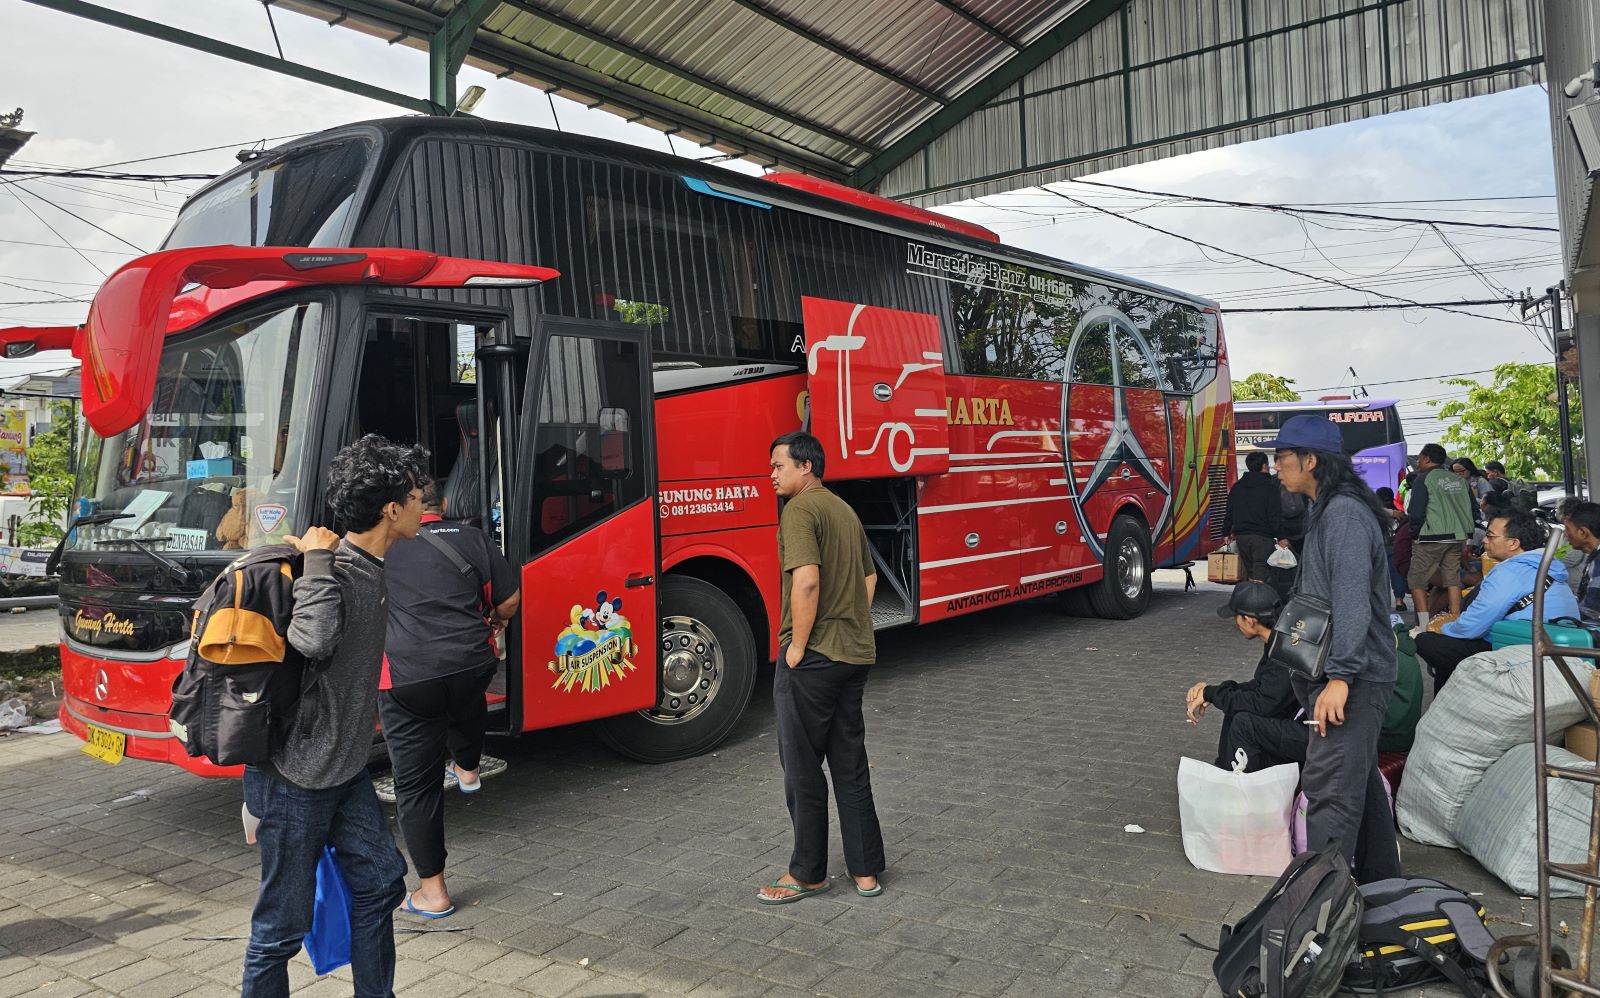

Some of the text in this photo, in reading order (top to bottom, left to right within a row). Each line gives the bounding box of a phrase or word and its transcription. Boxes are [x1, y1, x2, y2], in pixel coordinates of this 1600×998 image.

[907, 242, 1026, 287] Mercedes-Benz
[732, 366, 766, 377] JETBUS
[147, 412, 178, 422] BIL
[715, 485, 759, 500] HARTA
[671, 501, 735, 516] 08123863434
[166, 532, 205, 551] DENPASAR
[946, 573, 1082, 612] ANTAR KOTA ANTAR PROPINSI
[75, 609, 135, 639] Gunung Harta
[570, 639, 618, 670] AIR SUSPENSION
